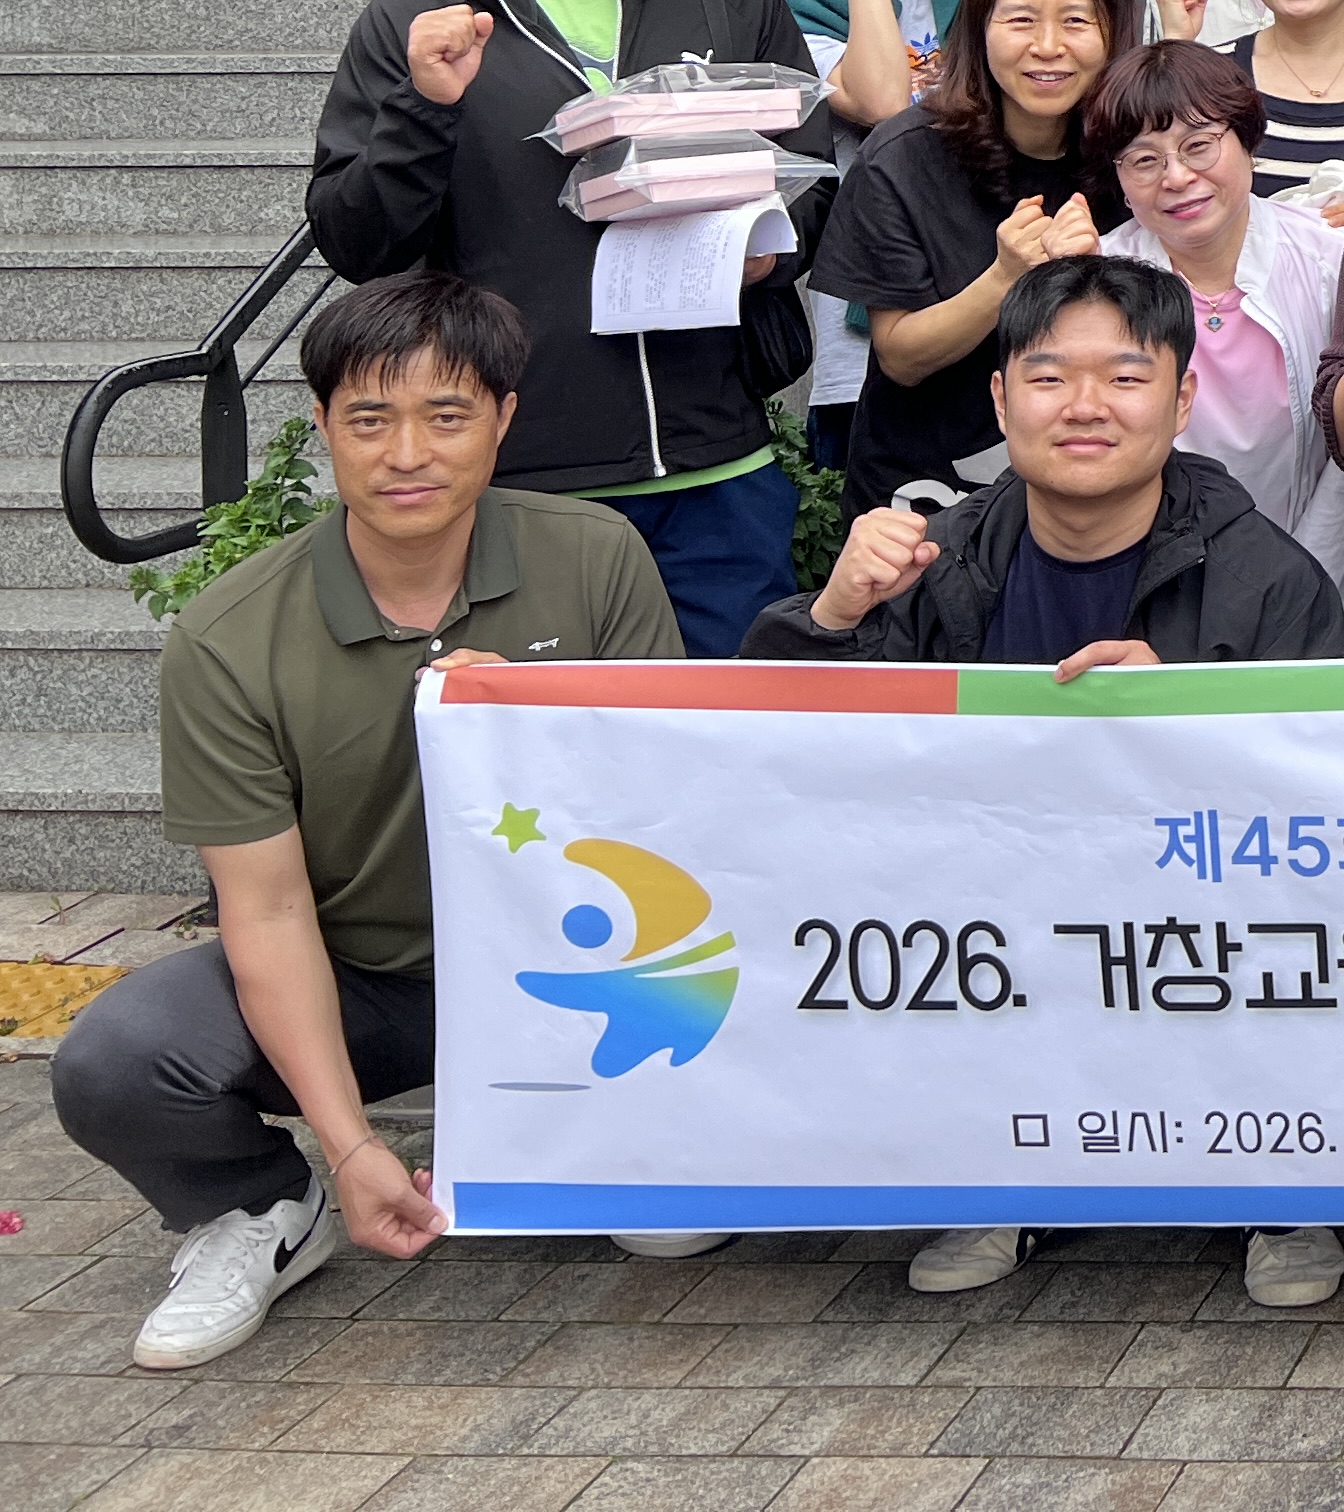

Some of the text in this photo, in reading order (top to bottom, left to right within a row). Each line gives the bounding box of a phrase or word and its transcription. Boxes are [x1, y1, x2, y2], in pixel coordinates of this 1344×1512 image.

[795, 919, 1027, 1011] 2026.
[1078, 1111, 1183, 1153] 일시:
[1205, 1111, 1336, 1153] 2026.
